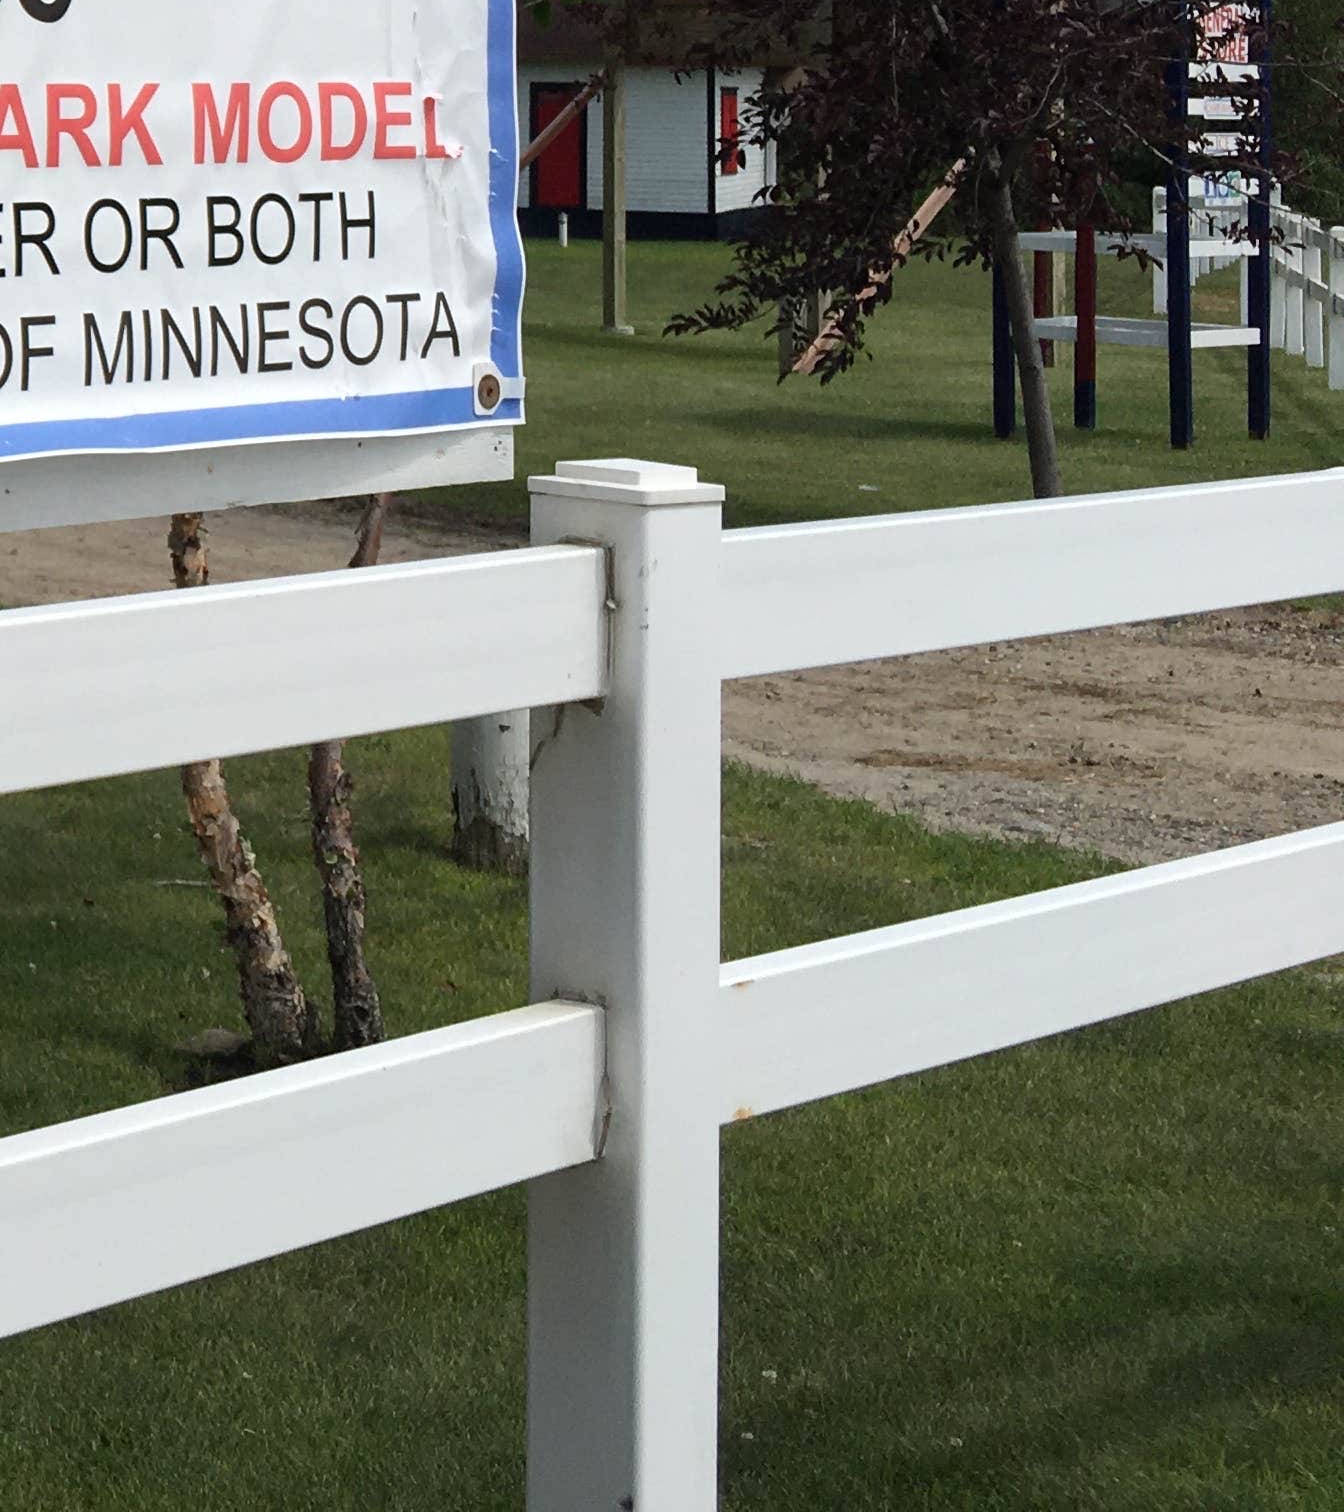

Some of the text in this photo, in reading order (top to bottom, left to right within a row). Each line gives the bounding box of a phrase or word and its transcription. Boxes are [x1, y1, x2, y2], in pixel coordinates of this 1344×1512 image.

[193, 82, 461, 164] MODEL
[85, 198, 183, 273] OR
[207, 191, 375, 266] BOTH
[83, 291, 461, 388] MINNESOTA
